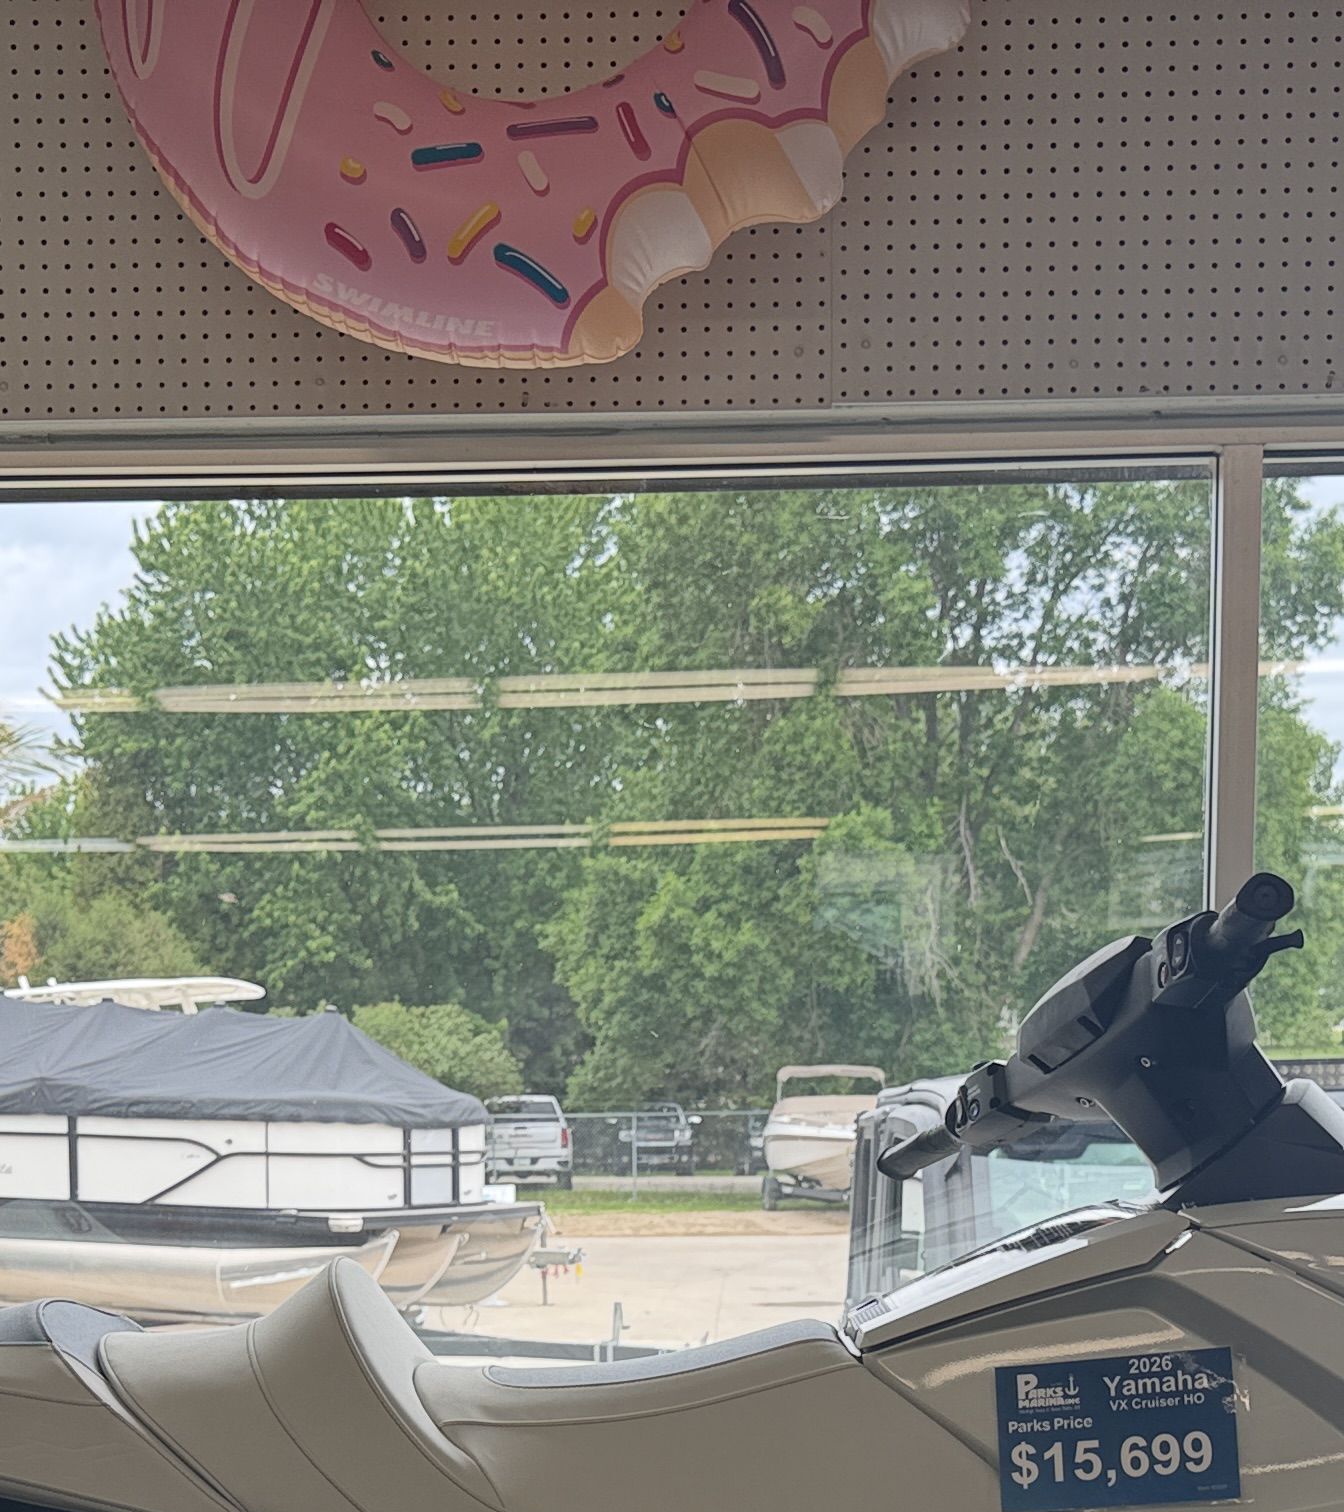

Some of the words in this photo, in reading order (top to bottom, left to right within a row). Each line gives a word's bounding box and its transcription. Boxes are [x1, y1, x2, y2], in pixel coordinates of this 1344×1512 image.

[312, 272, 497, 337] SWIMLINE
[1128, 1356, 1173, 1375] 2026
[1102, 1370, 1210, 1398] Yamaha
[1109, 1399, 1130, 1412] VX
[1131, 1395, 1181, 1410] Cruiser
[1183, 1392, 1206, 1406] HO
[1007, 1417, 1052, 1434] Parks
[1053, 1414, 1094, 1431] Price
[1009, 1430, 1214, 1490] $15,699
